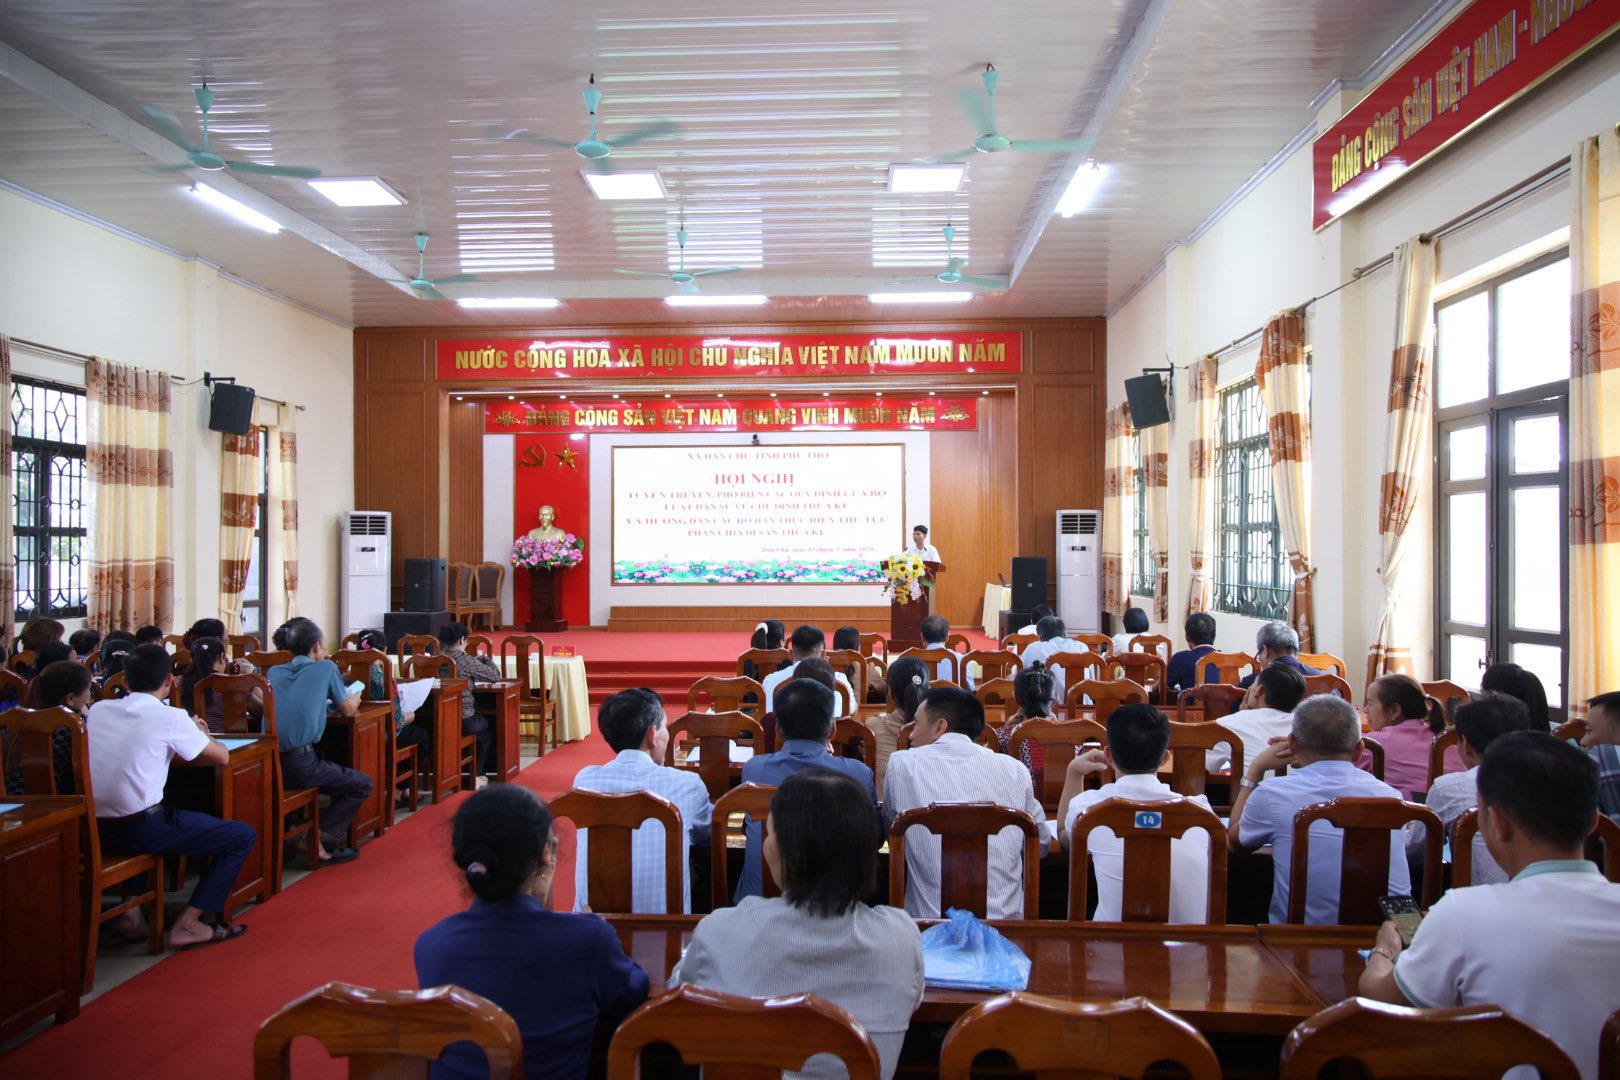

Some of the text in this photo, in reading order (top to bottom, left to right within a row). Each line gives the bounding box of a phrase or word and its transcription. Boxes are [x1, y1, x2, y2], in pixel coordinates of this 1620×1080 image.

[1332, 134, 1362, 192] ĐẢNG
[1364, 111, 1400, 170] CỘNG
[1403, 75, 1432, 140] SẢN
[1436, 45, 1470, 114] VIỆT
[1474, 9, 1516, 88] NAM
[455, 345, 508, 370] NƯỚC
[617, 345, 645, 368] XÃ
[651, 343, 683, 371] HỘI
[798, 341, 840, 368] VIỆT
[845, 344, 891, 364] NAM
[959, 338, 1005, 362] NĂM
[526, 401, 935, 430] ĐẢNG CỘNG SẢN VIỆT NAM QUANG VINH MUÔN NĂM
[1142, 815, 1155, 825] 14
